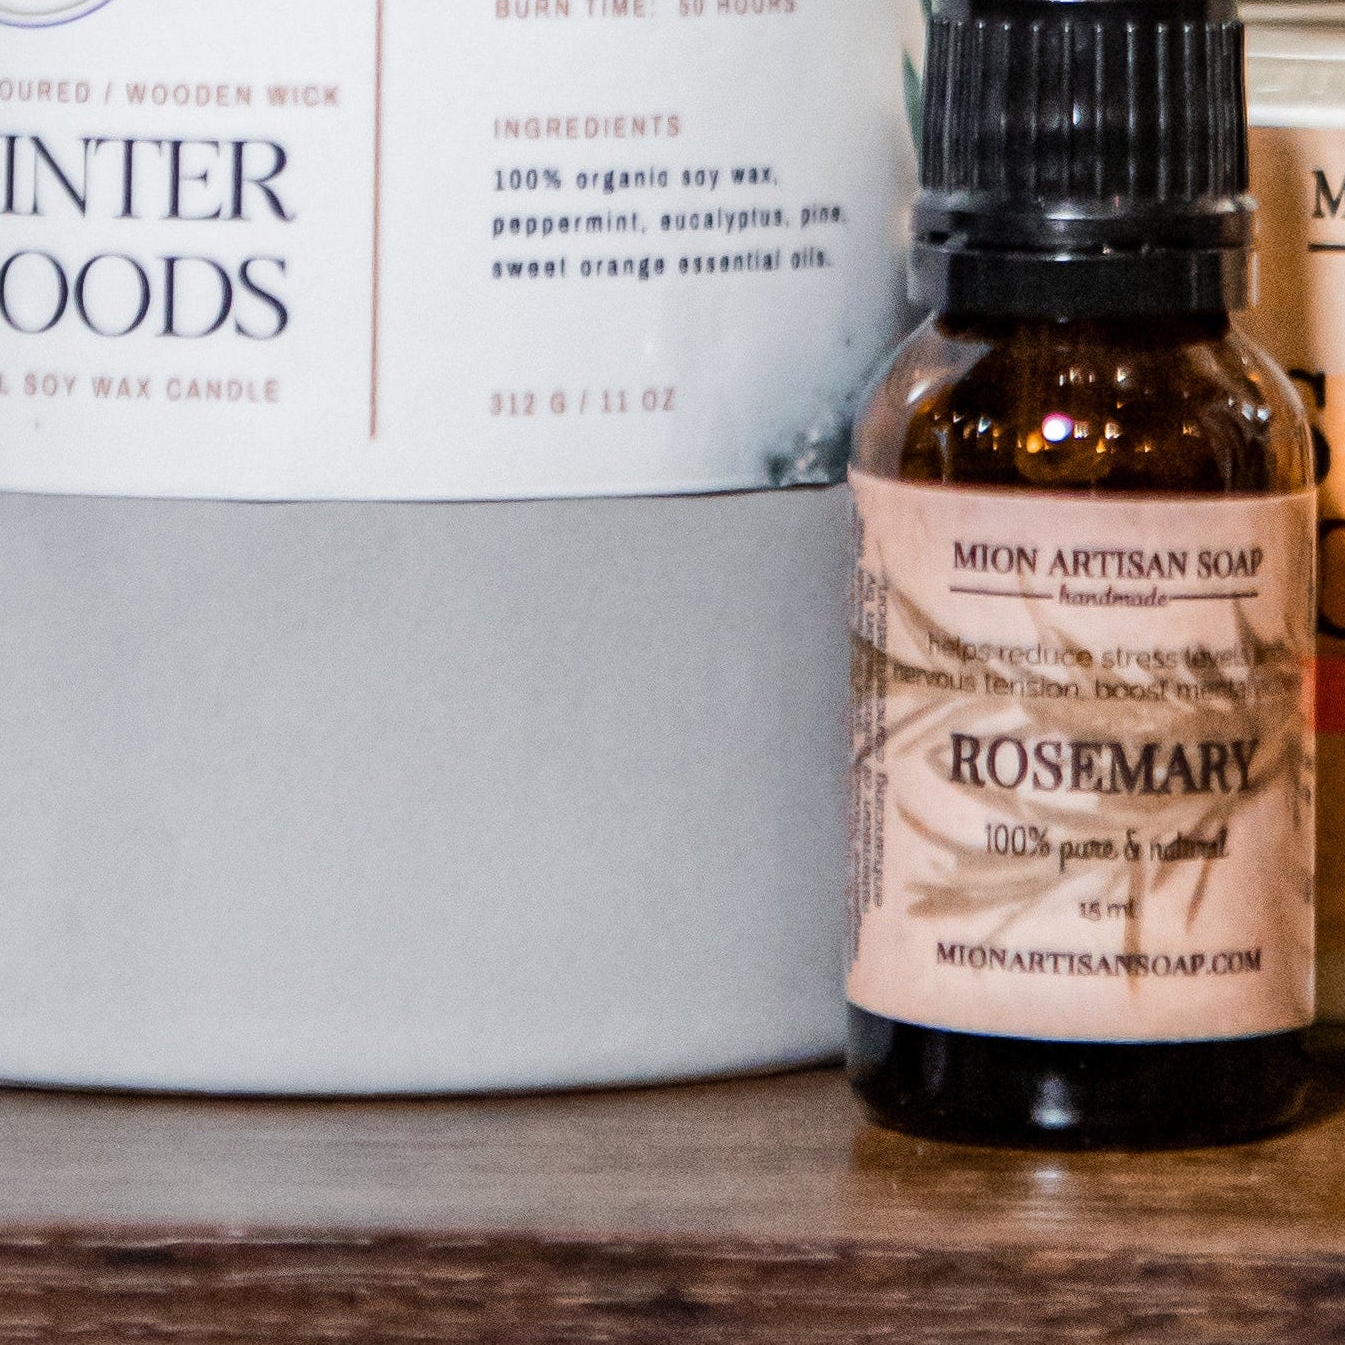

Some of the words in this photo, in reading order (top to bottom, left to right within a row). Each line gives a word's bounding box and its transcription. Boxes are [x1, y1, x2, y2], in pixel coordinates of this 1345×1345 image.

[125, 81, 252, 107] WOODEN
[265, 84, 341, 108] WICK
[493, 115, 683, 141] INGREDIENTS
[494, 167, 562, 191] 100%
[575, 166, 669, 195] organic
[681, 167, 720, 191] soy
[730, 165, 779, 188] wax,
[492, 210, 648, 239] peppermint,
[660, 208, 791, 235] eucalyptus,
[491, 255, 567, 280] sweet
[579, 255, 666, 282] orange
[677, 251, 782, 276] essential
[23, 373, 76, 398] SOY
[91, 375, 153, 400] WAX
[166, 377, 280, 404] CANDLE
[490, 392, 536, 417] 312
[550, 391, 567, 416] G
[601, 389, 627, 413] 11
[640, 386, 678, 413] OZ
[953, 541, 1038, 575] MION
[1047, 548, 1189, 580] ARTISAN
[1197, 548, 1264, 580] SOAP
[1057, 585, 1169, 608] handmade
[1102, 643, 1180, 671] stress
[1093, 677, 1171, 703] boost
[951, 732, 1259, 796] ROSEMARY
[984, 821, 1051, 858] 100%
[1059, 837, 1119, 876] pure
[1149, 827, 1229, 861] natural
[936, 942, 1262, 977] MIONARTISANSOAP.COM
